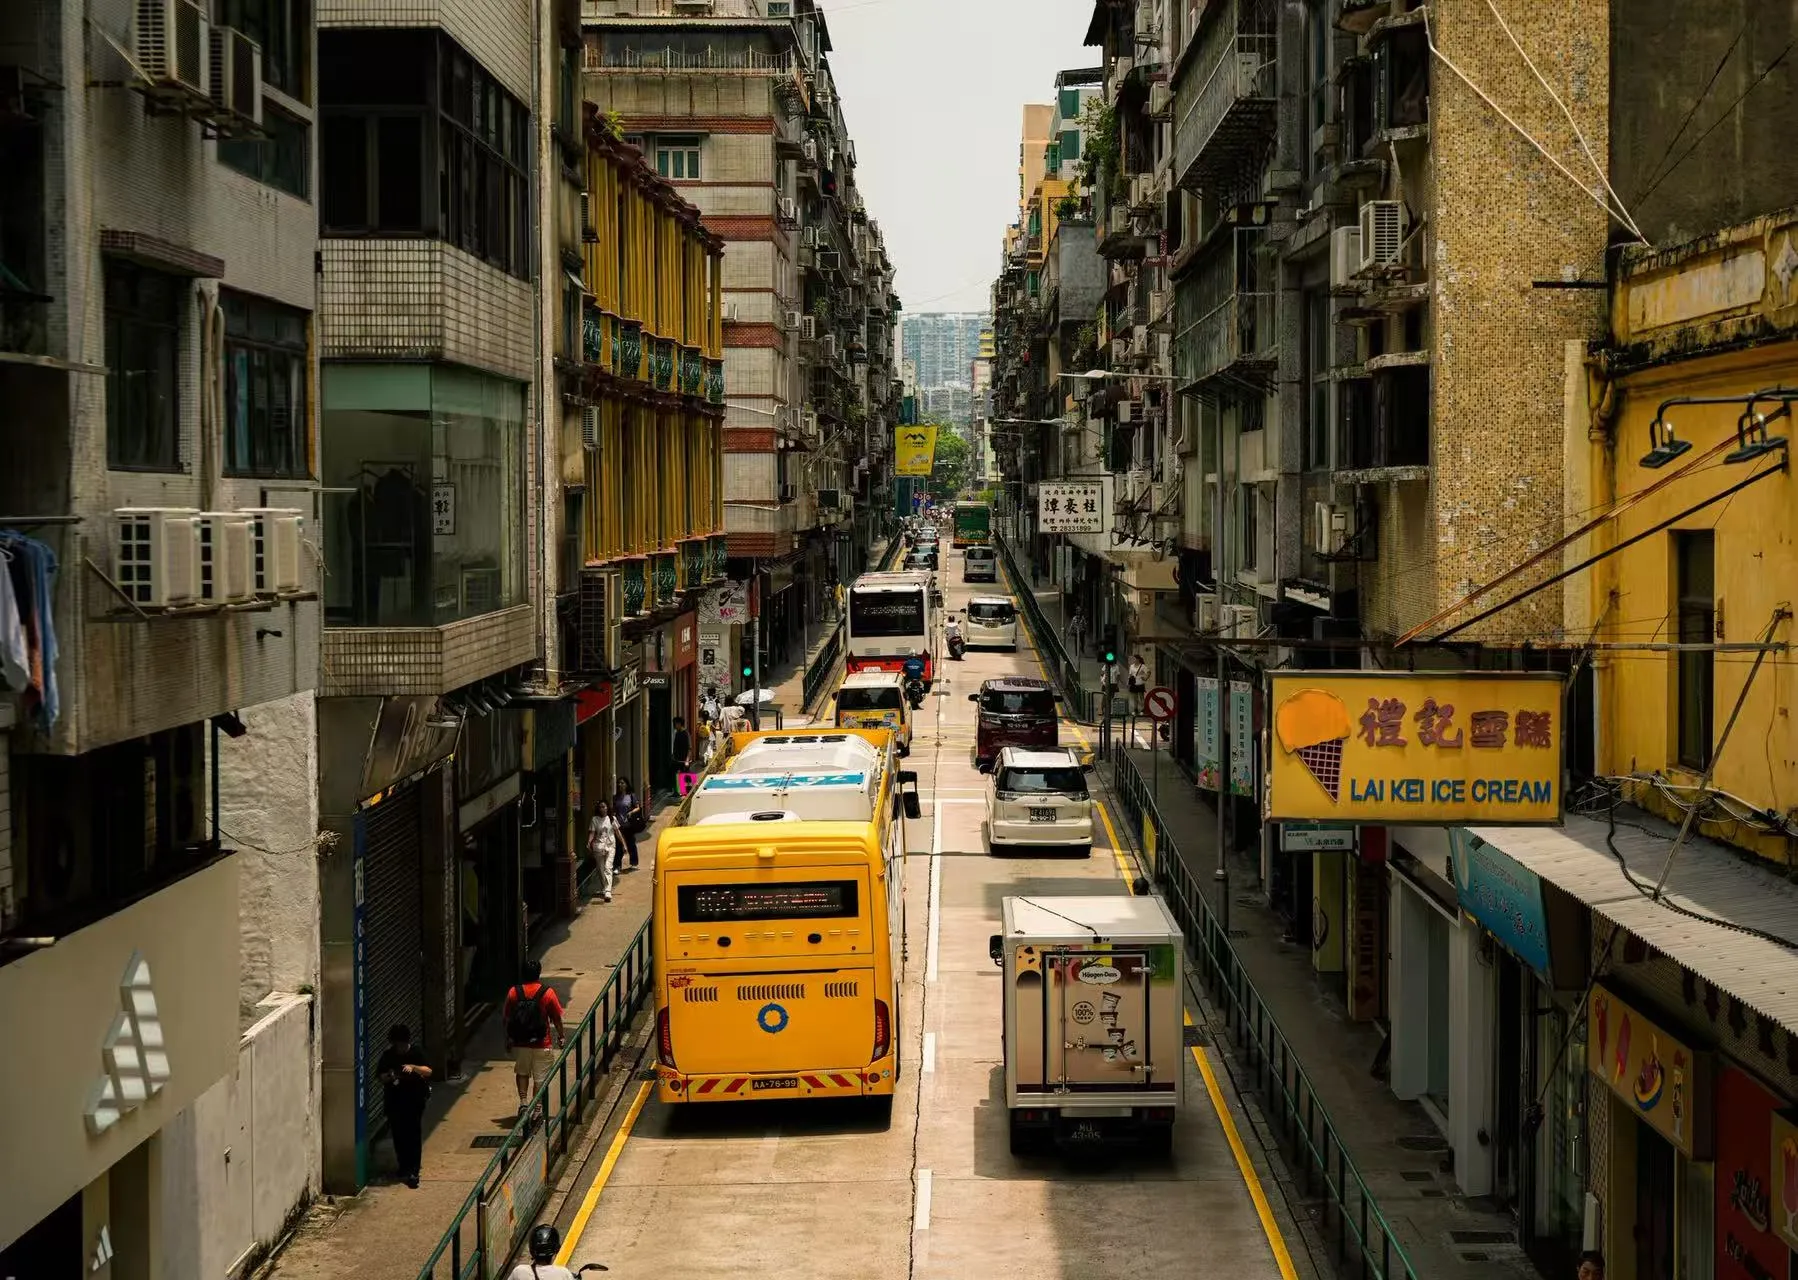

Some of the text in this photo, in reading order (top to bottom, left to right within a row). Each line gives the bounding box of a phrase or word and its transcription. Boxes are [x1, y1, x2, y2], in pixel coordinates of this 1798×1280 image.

[1044, 497, 1097, 515] 譚豪柱
[1357, 696, 1552, 749] 禮記雪糕
[1350, 778, 1551, 803] LAI KEI ICE CREAM
[1075, 1008, 1094, 1017] 100%
[752, 1079, 797, 1089] AA-76-99
